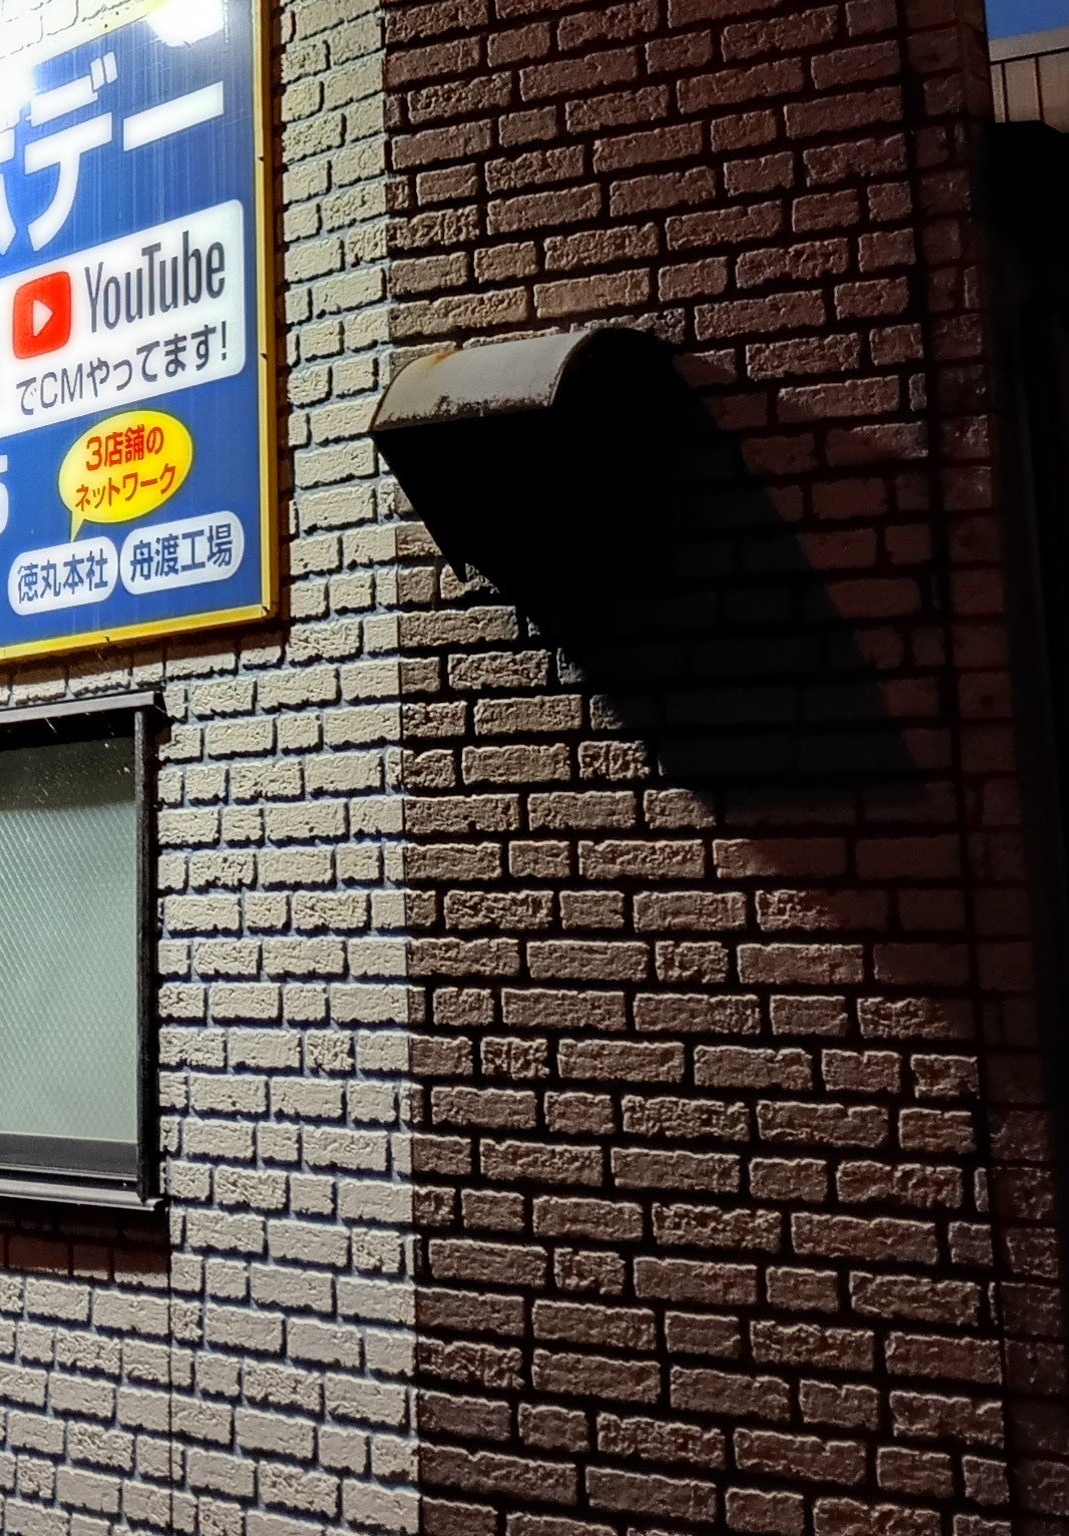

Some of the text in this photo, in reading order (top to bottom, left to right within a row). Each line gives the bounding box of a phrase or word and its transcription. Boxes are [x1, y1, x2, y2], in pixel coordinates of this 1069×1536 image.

[84, 230, 226, 333] YouTube
[16, 320, 227, 415] でCMやってます!
[85, 423, 165, 472] 3店舗の
[75, 463, 176, 512] ネットワーク
[17, 547, 108, 605] 徳丸本社
[130, 522, 233, 582] 舟渡工場
